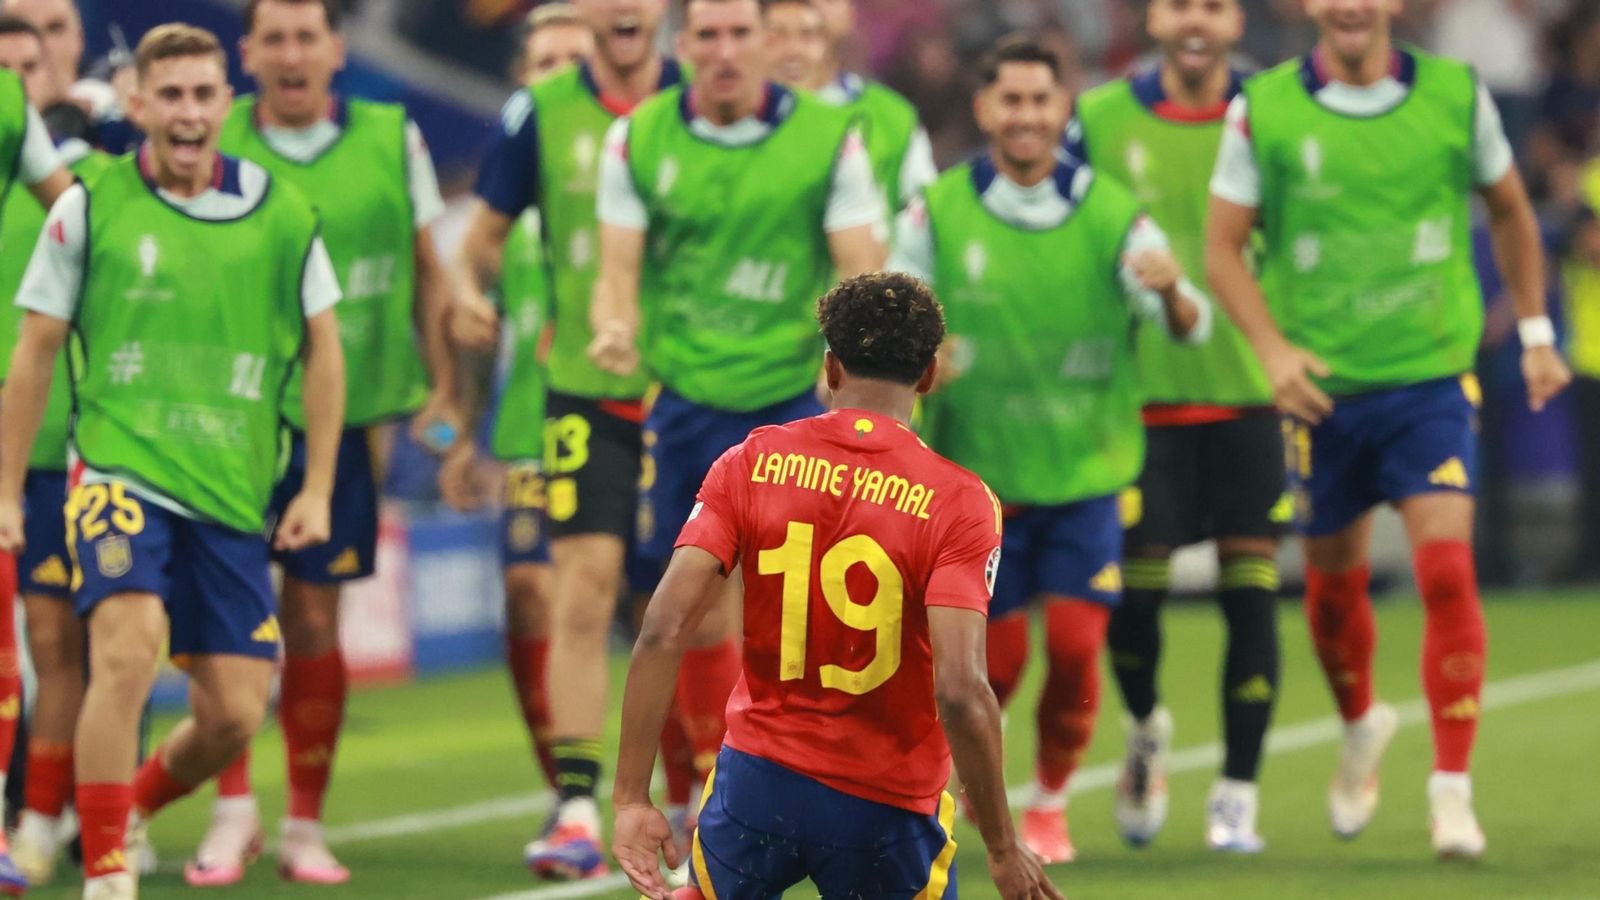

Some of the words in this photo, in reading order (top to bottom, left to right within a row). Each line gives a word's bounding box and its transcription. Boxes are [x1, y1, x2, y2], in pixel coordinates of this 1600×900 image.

[543, 413, 591, 476] 13
[80, 480, 145, 542] 25
[751, 452, 848, 496] LAMINE
[851, 466, 935, 519] YAMAL
[758, 520, 903, 695] 19
